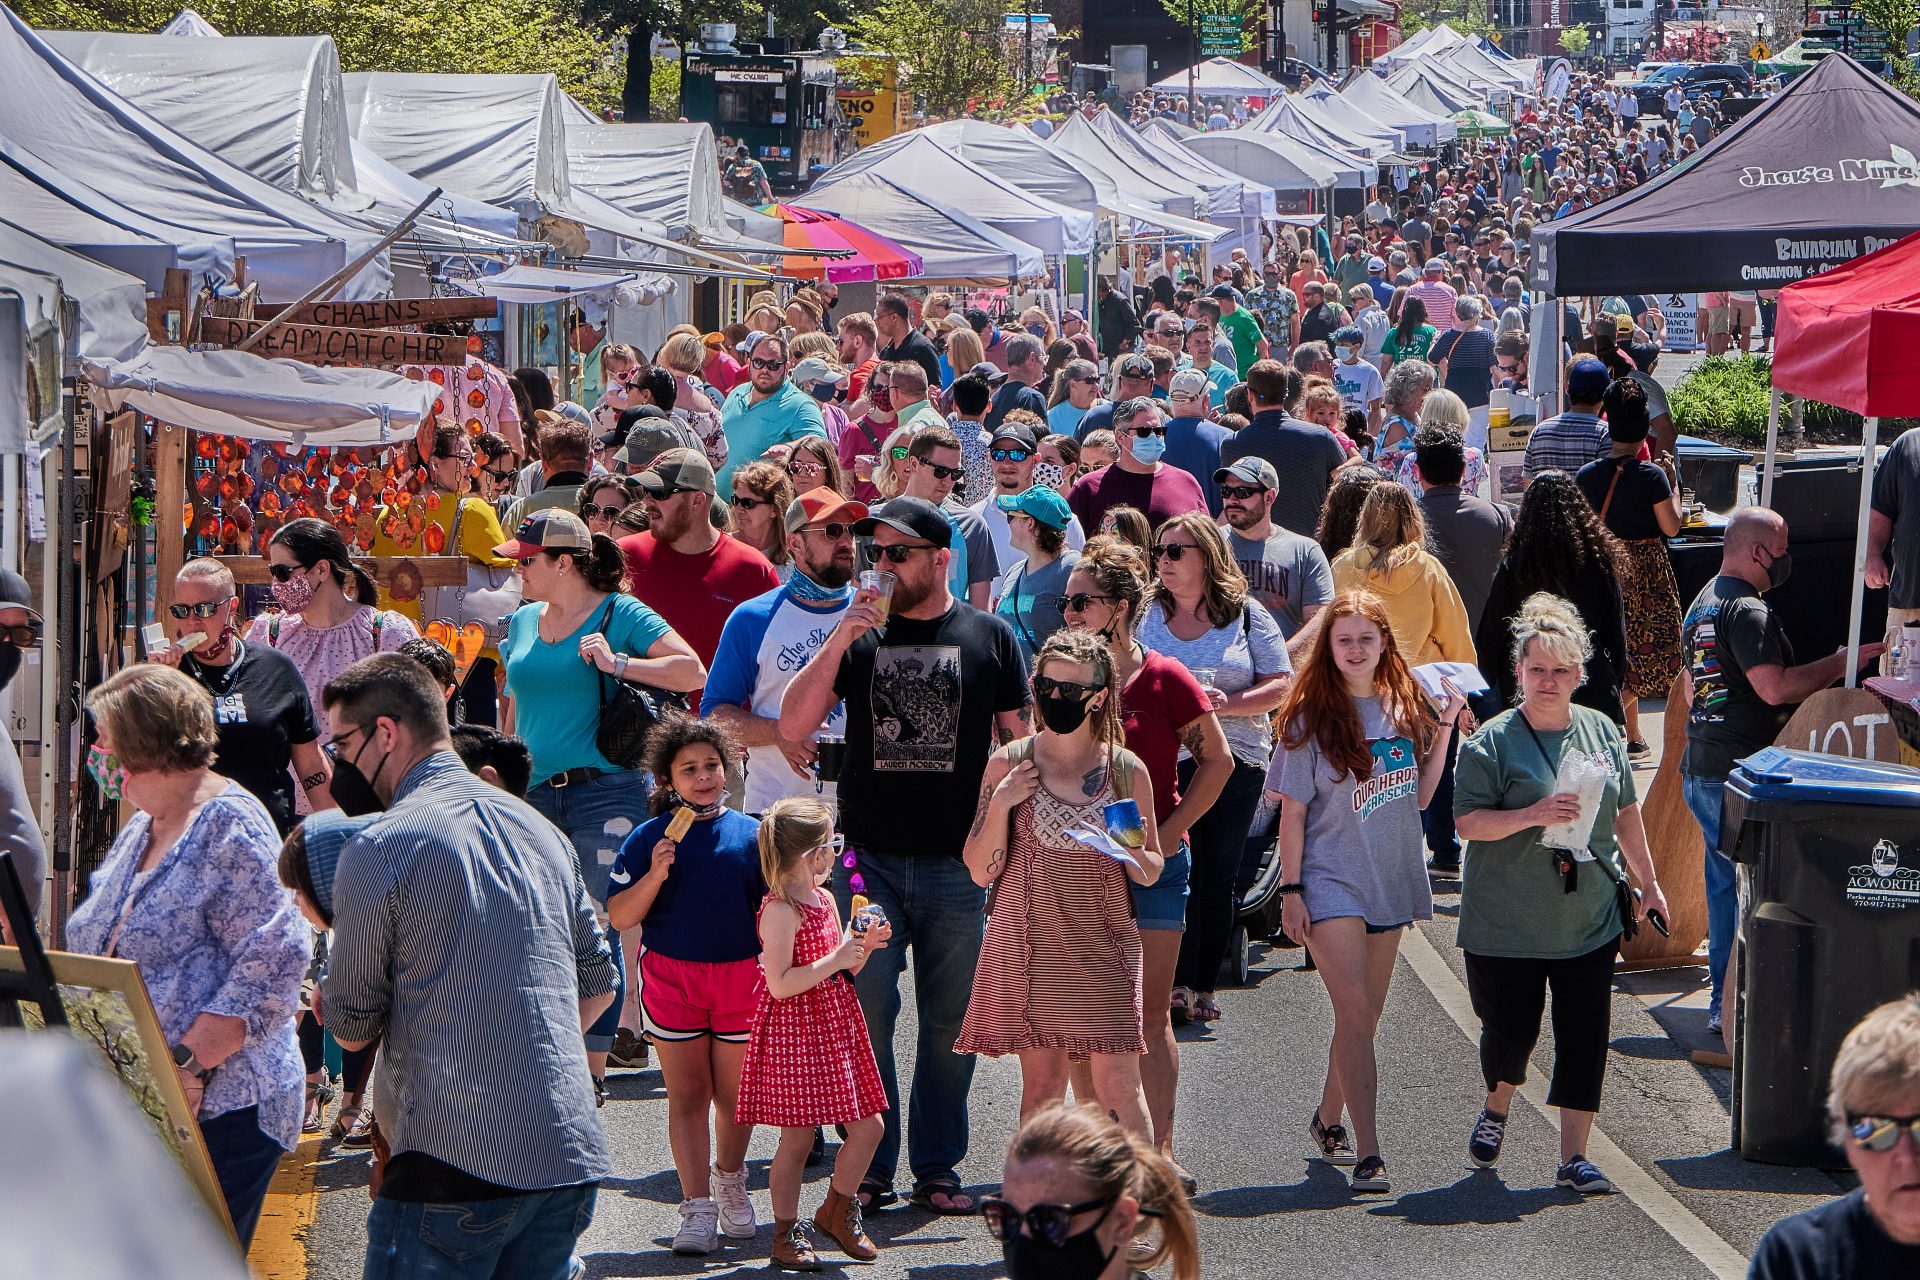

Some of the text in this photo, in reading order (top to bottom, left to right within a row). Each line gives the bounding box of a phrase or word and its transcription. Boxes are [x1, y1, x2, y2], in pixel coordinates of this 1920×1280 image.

[1775, 238, 1858, 261] BAVARIAN
[1741, 264, 1803, 280] CINNAMON
[313, 300, 421, 326] CHAINS
[1667, 327, 1689, 335] TUDIO
[776, 628, 829, 672] The Sh
[908, 760, 948, 770] MORROW
[1352, 779, 1377, 813] OUR
[1360, 791, 1386, 823] WEAR
[1847, 876, 1920, 891] ACWORTH
[1846, 893, 1866, 901] Parks
[1882, 895, 1920, 904] Recreation
[1854, 900, 1906, 909] 770-917-1234
